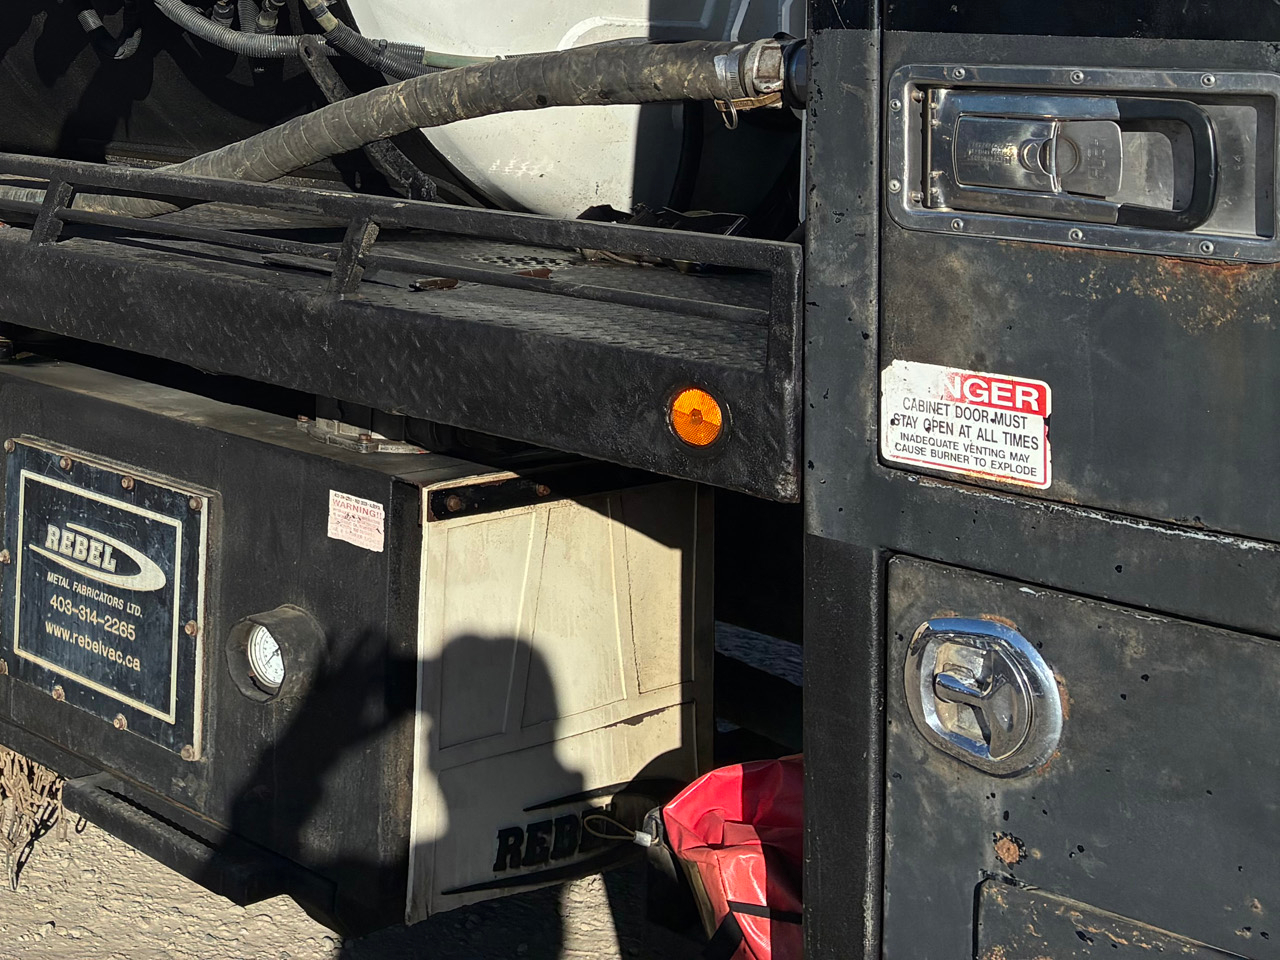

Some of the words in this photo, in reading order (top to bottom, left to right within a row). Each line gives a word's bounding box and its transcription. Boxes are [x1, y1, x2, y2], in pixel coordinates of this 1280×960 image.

[941, 375, 1040, 412] NGER
[892, 413, 918, 430] STAY
[923, 418, 954, 436] OPEN
[958, 425, 973, 439] AT
[977, 427, 998, 444] ALL
[1003, 431, 1039, 451] TIMES
[902, 397, 951, 418] CABINET
[955, 406, 989, 423] DOOR
[994, 411, 1027, 430] MUST
[894, 442, 927, 456] CAUSE
[930, 450, 970, 465] BURNER
[974, 456, 987, 468] TO
[991, 460, 1038, 477] EXPLODE
[900, 431, 960, 451] INADEQUATE
[963, 442, 1006, 459] VENTING
[1010, 451, 1030, 464] MAY
[332, 498, 382, 520] WARNING!!
[44, 524, 117, 573] REBEL
[46, 571, 70, 589] METAL
[72, 581, 124, 611] FABRICATORS
[126, 602, 143, 618] LTD.
[50, 594, 136, 641] 403-314-2265
[45, 621, 141, 672] www.rebelvac.ca
